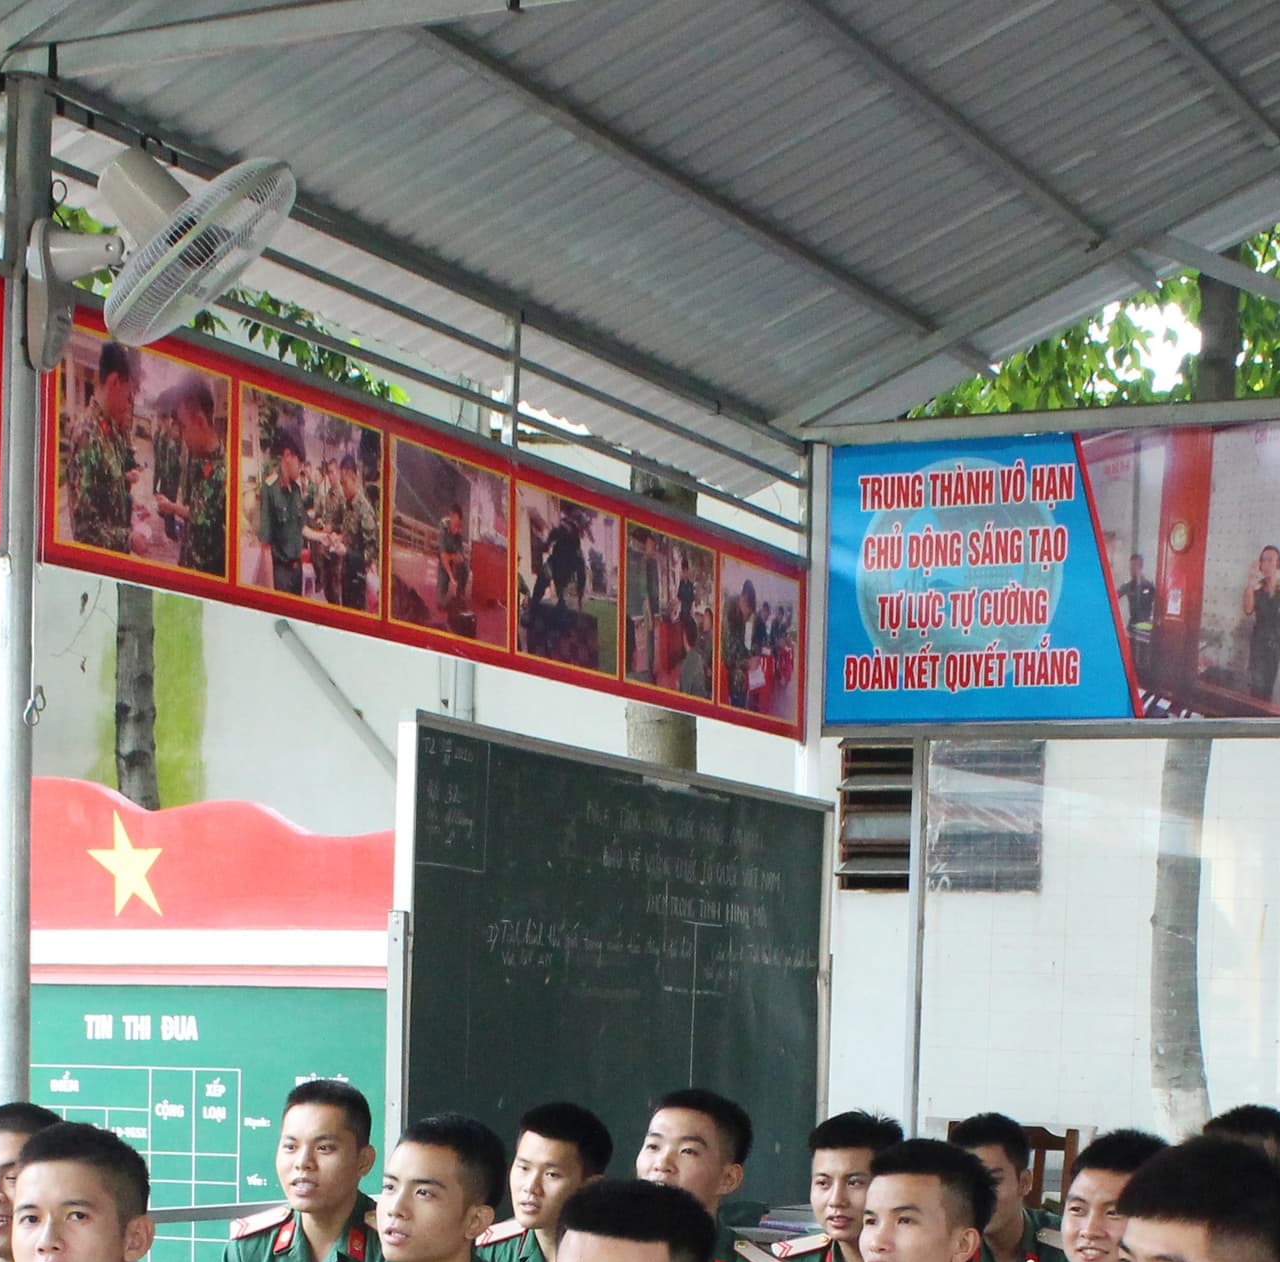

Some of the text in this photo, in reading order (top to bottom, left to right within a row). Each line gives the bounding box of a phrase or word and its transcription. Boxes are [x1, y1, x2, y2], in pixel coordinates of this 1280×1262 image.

[859, 459, 1075, 511] TRUNG THÀNH VÔ HẠN
[863, 522, 1068, 576] CHỦ ĐỘNG SÁNG TẠO
[878, 581, 1048, 637] TỰ LỰC TỰ CƯỜNG
[844, 635, 1080, 692] ĐOÀN KẾT QUYẾT THẮNG
[85, 1014, 198, 1041] TIN THI ĐUA
